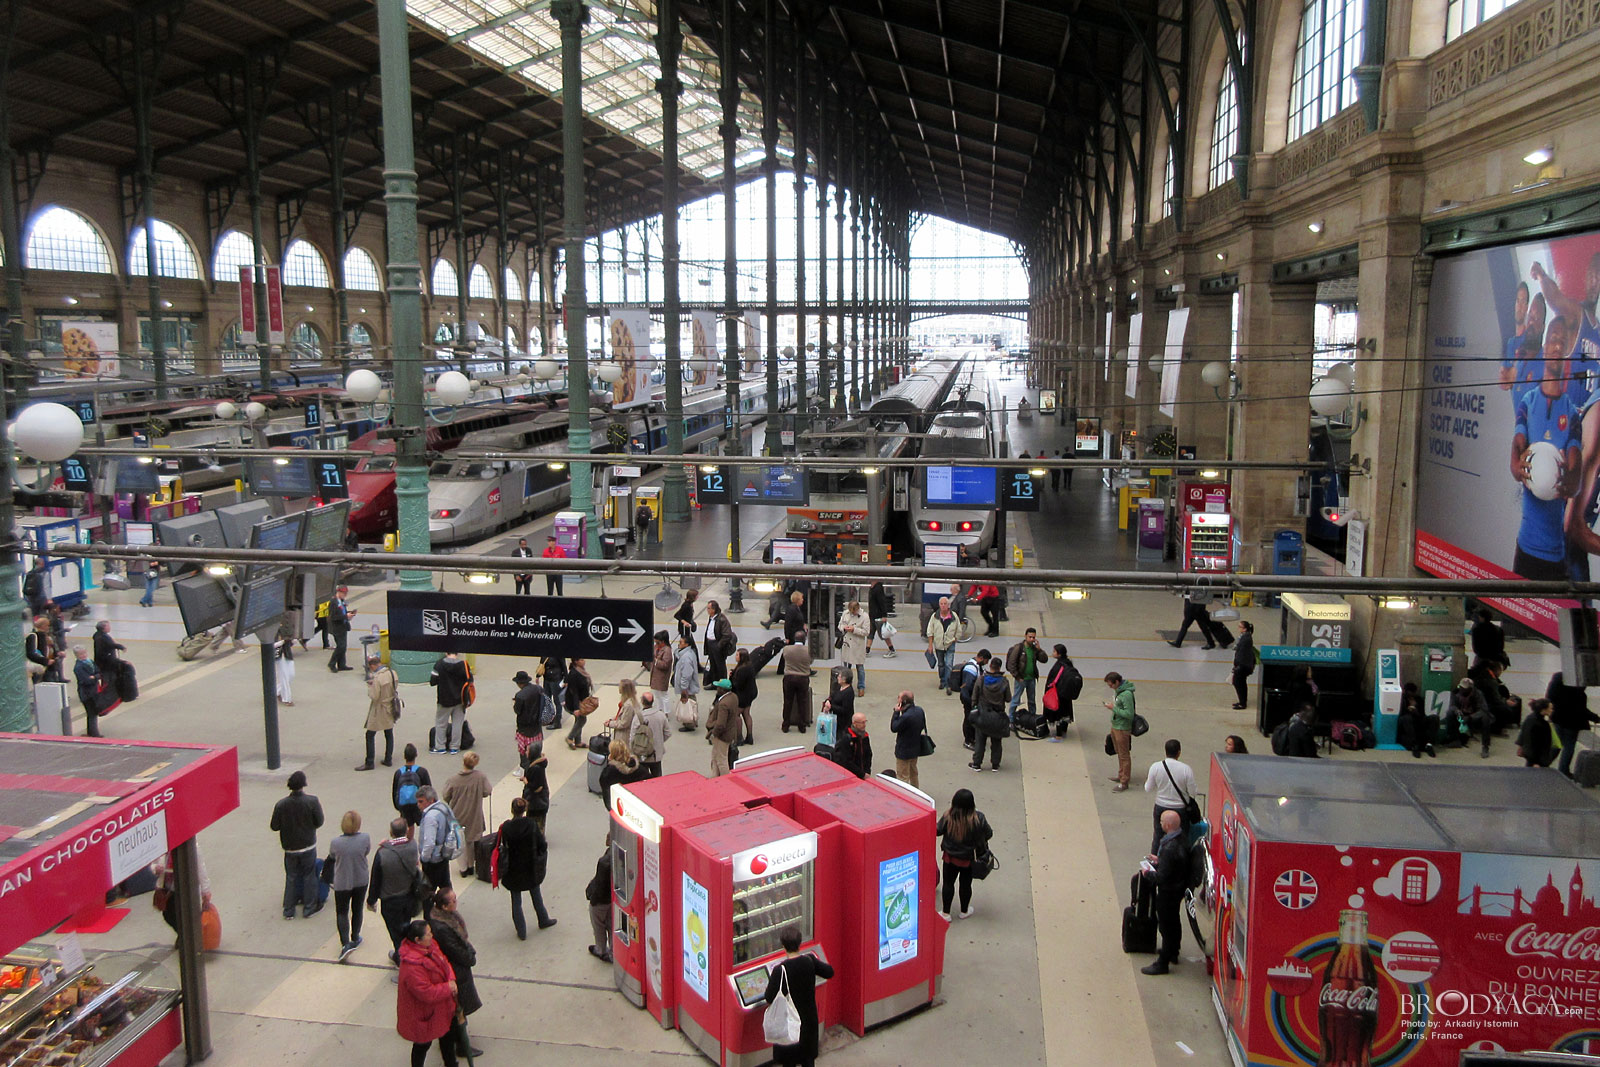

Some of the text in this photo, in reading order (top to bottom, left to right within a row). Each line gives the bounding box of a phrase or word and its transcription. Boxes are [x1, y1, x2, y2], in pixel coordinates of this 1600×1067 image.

[1432, 365, 1452, 384] QUE
[1431, 390, 1485, 414] LA FRANCE
[80, 408, 93, 419] 10
[307, 410, 318, 422] 11
[1430, 412, 1479, 440] SOIT AVEC
[1428, 436, 1454, 459] VOUS
[66, 465, 86, 479] 10
[322, 470, 340, 484] 11
[703, 475, 723, 490] 12
[1012, 481, 1033, 496] 13
[819, 512, 843, 520] SNCF
[451, 611, 582, 629] Réseau Ile-de-France
[1307, 610, 1349, 618] Photomaton
[452, 628, 563, 640] Suburban lines Nahverkehr
[591, 625, 610, 634] BUS
[1278, 649, 1298, 657] VOUS
[1312, 650, 1337, 658] JOUER
[41, 787, 175, 872] CHOCOLATES
[117, 820, 159, 856] neuhaus
[771, 848, 806, 866] selecta
[1474, 932, 1504, 941] AVEC
[1516, 965, 1600, 984] OUVREZ
[1319, 983, 1378, 1010] Coca-Cola
[1488, 981, 1600, 1002] DU BONHE
